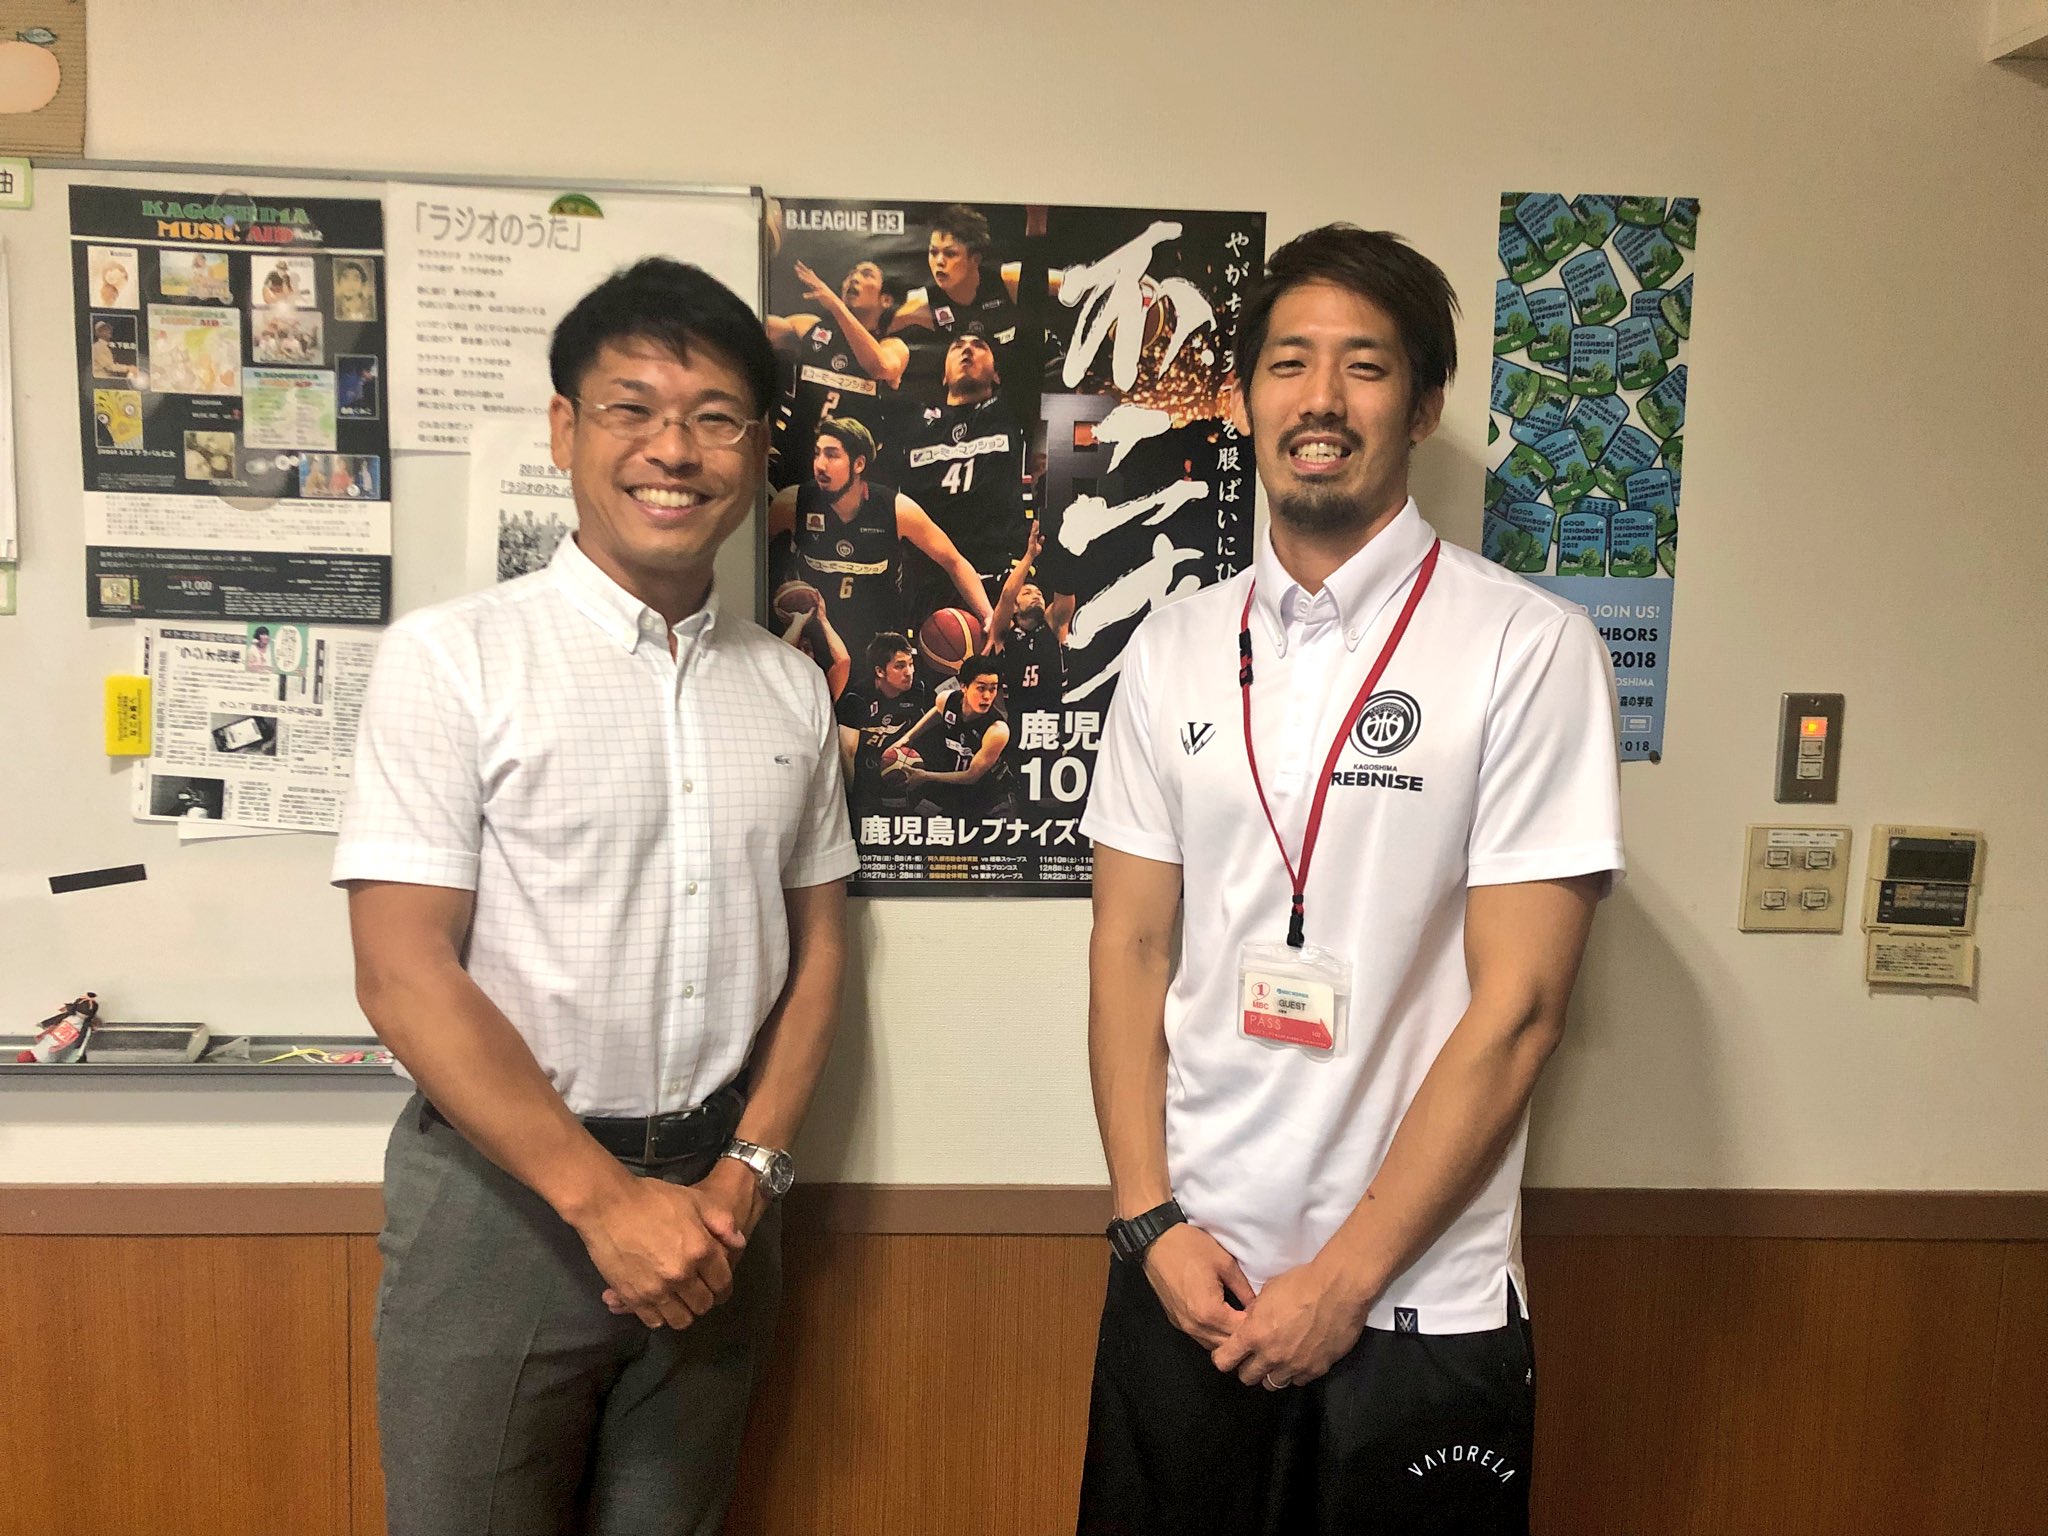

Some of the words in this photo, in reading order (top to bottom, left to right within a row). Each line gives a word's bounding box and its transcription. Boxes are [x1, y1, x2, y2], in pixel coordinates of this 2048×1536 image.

[157, 219, 241, 242] MUSIC
[245, 224, 294, 243] AID
[785, 209, 868, 231] B.LEAGUE
[941, 458, 975, 494] 41
[839, 576, 854, 599] 6
[1593, 604, 1631, 618] JOIN
[1635, 605, 1660, 619] US!
[1611, 651, 1656, 668] 2018
[1022, 664, 1039, 687] 55
[1018, 709, 1101, 750] 鹿児
[1619, 741, 1650, 752] 018
[1353, 763, 1398, 772] KAGOSHIMA
[1020, 757, 1088, 803] 10
[1331, 771, 1424, 792] REBNISE
[860, 815, 1079, 847] 鹿児島レブナイズ
[1252, 1001, 1270, 1010] MBC
[1278, 999, 1307, 1011] GUEST
[1249, 1015, 1282, 1031] PASS
[1408, 1445, 1516, 1483] VAYORELA
